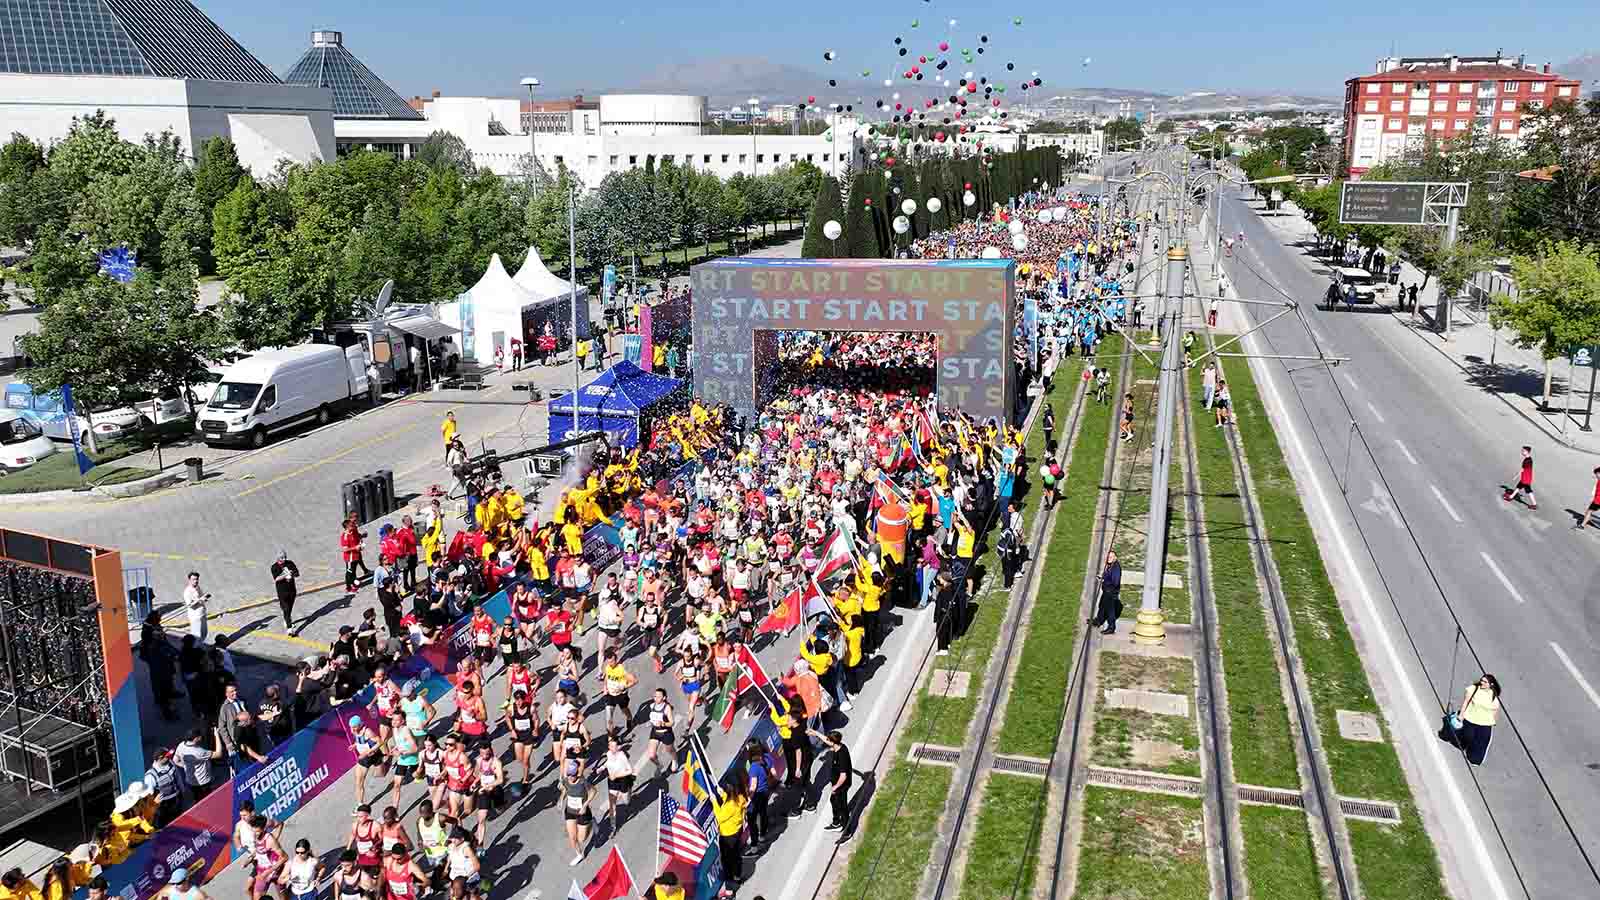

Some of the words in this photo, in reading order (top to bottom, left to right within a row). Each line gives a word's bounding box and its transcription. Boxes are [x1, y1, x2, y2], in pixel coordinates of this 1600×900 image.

[752, 271, 852, 292] START
[864, 271, 973, 292] START
[711, 298, 811, 319] START
[823, 299, 929, 320] START
[943, 299, 1005, 321] STA
[942, 357, 1004, 379] STA
[250, 756, 298, 800] KONYA
[270, 767, 303, 799] YARI
